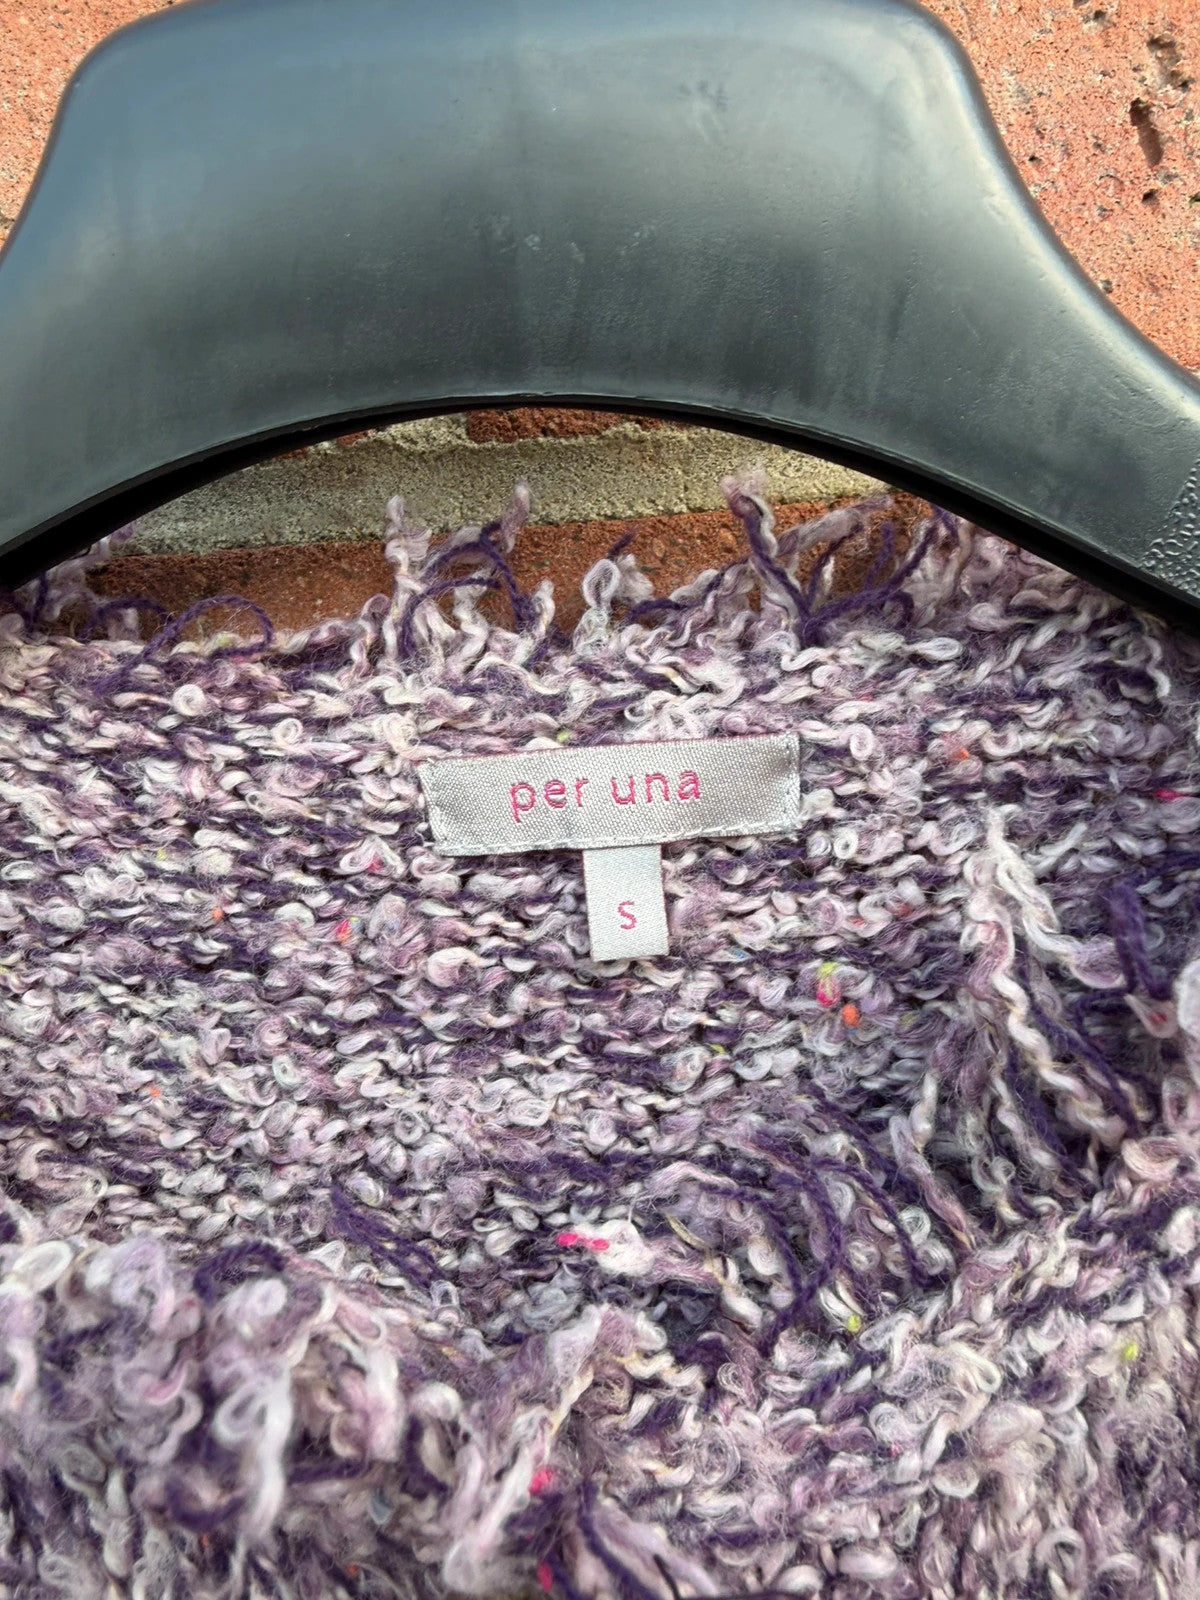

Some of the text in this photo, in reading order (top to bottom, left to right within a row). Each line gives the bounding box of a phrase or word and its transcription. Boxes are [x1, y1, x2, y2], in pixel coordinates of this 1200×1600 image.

[509, 769, 702, 822] per una
[617, 900, 638, 931] S
